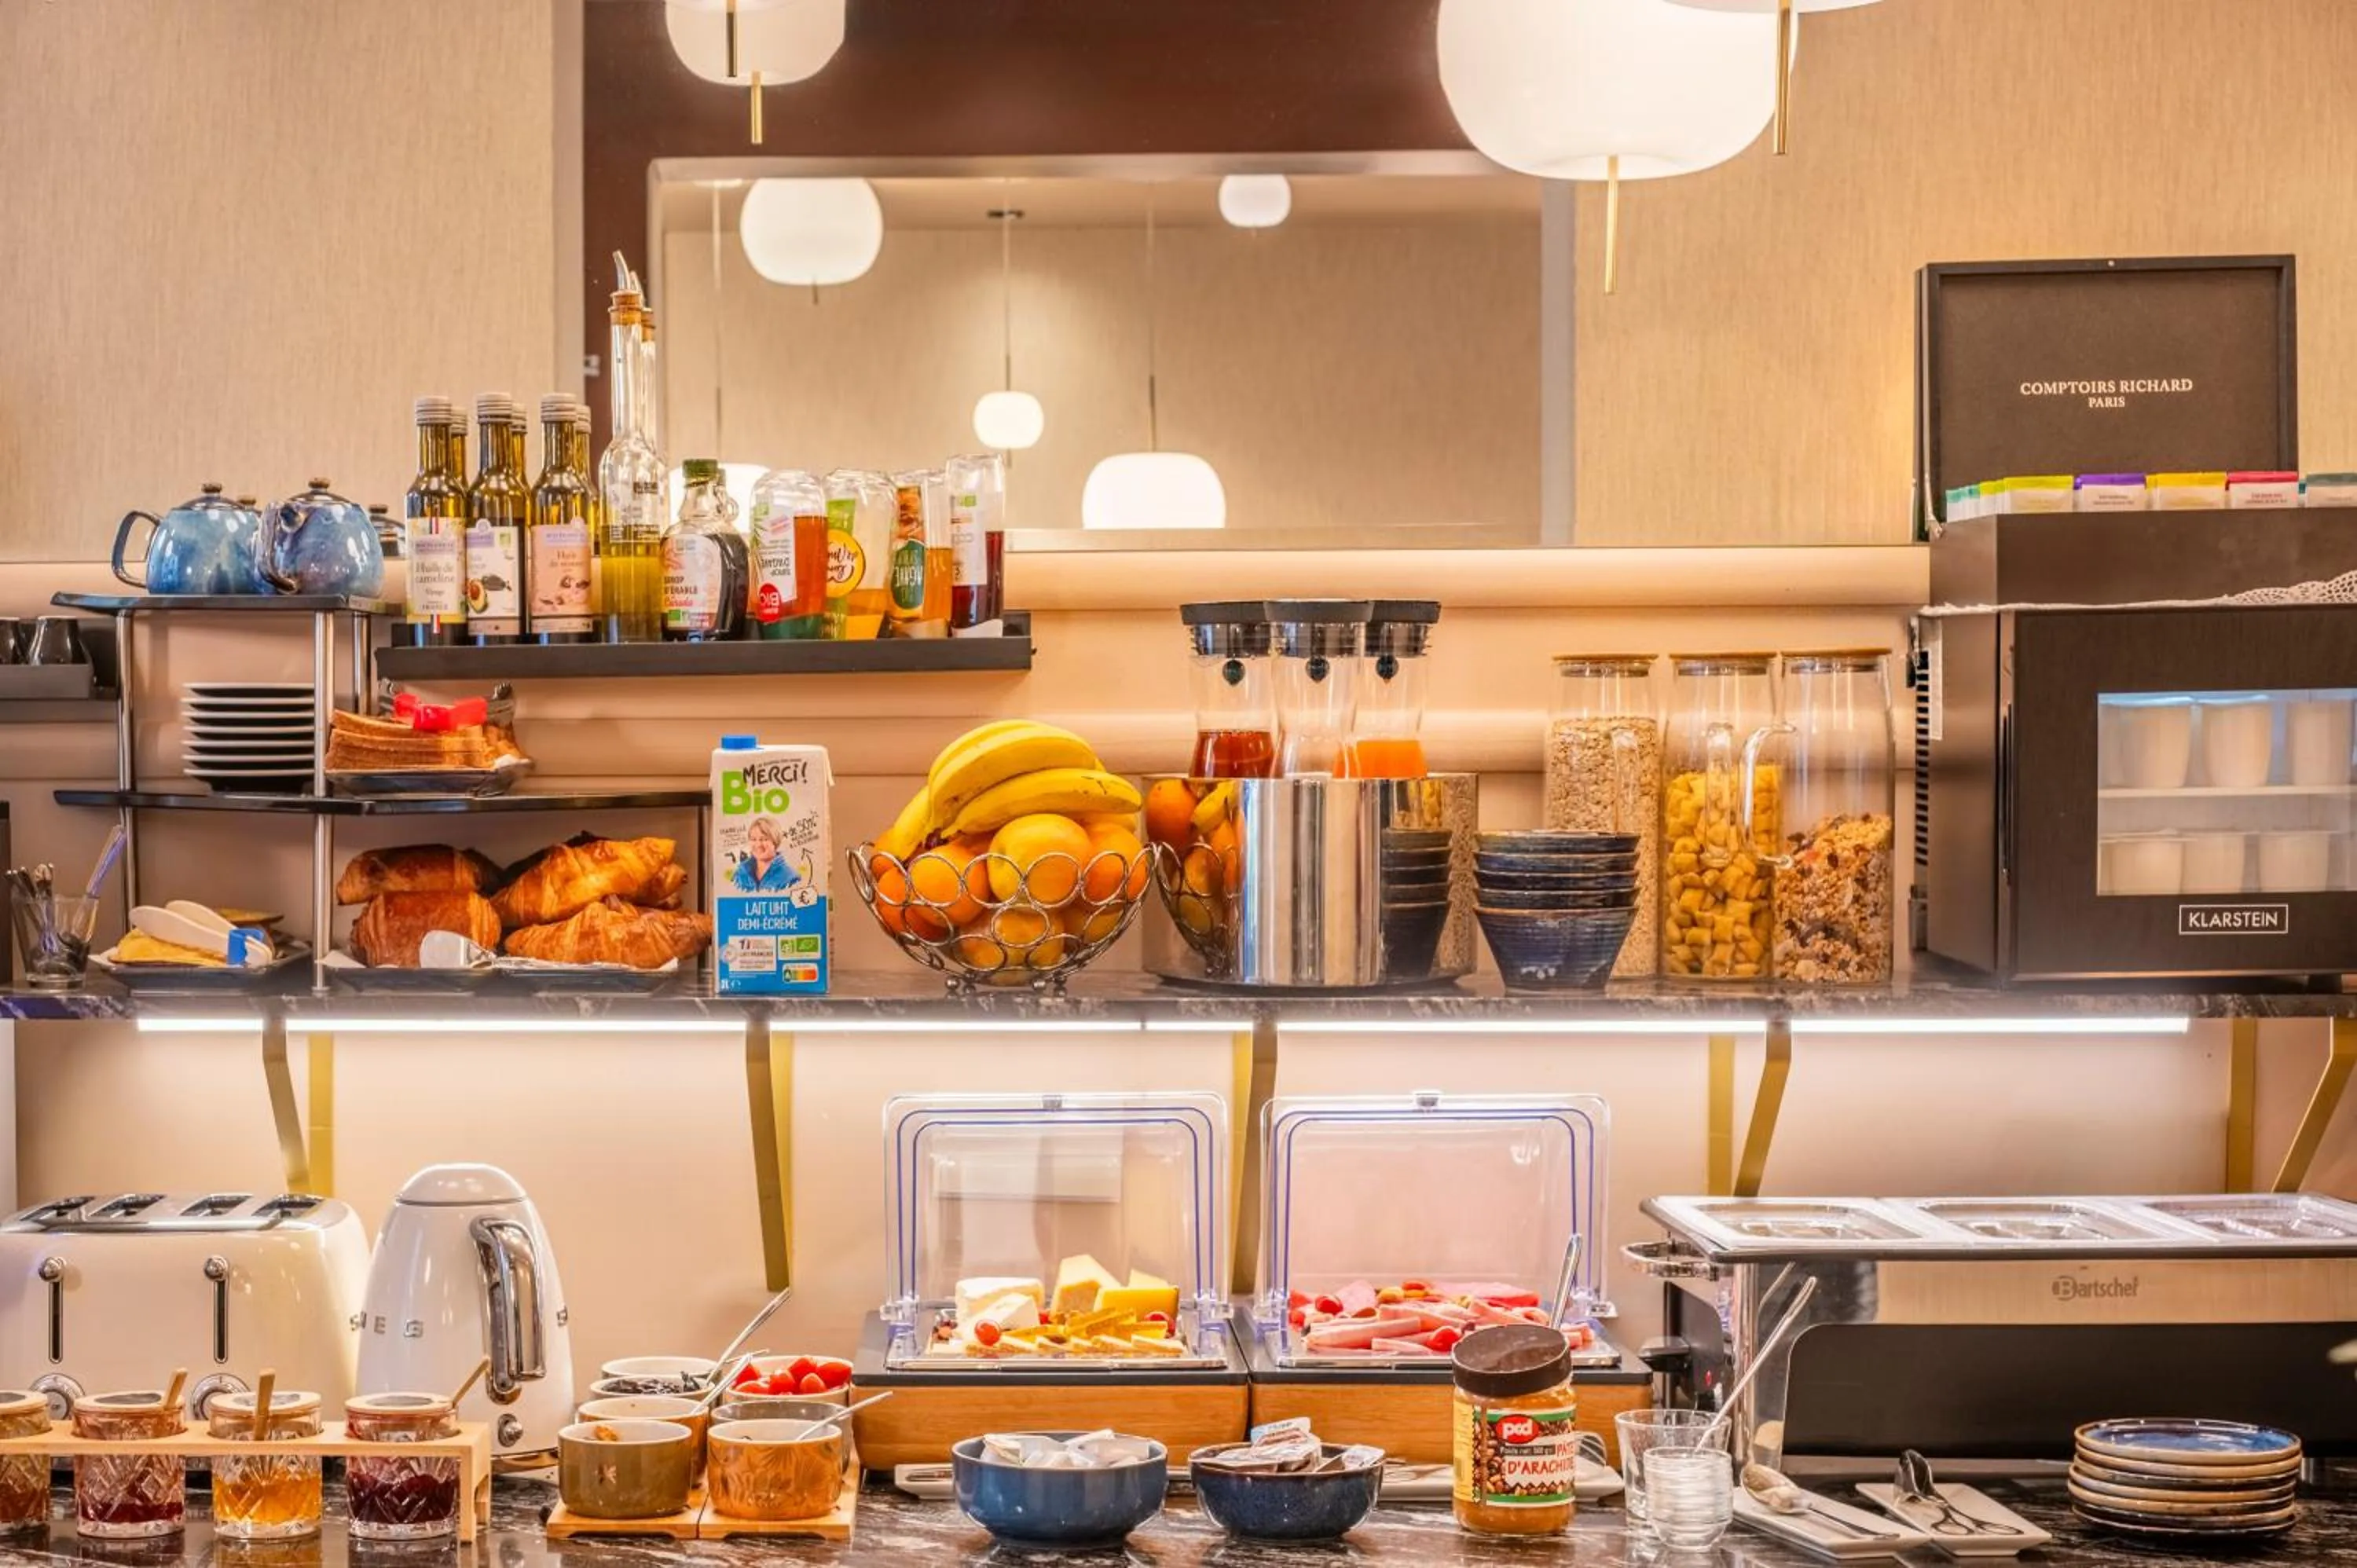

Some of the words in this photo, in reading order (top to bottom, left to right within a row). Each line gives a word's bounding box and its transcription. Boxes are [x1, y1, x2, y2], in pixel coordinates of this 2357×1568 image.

[2020, 380, 2116, 394] COMPTOIRS
[2120, 378, 2193, 393] RICHARD
[2088, 396, 2125, 408] PARIS
[746, 900, 768, 916] LAIT
[769, 900, 790, 916] UHT
[2189, 911, 2278, 928] KLARSTEIN
